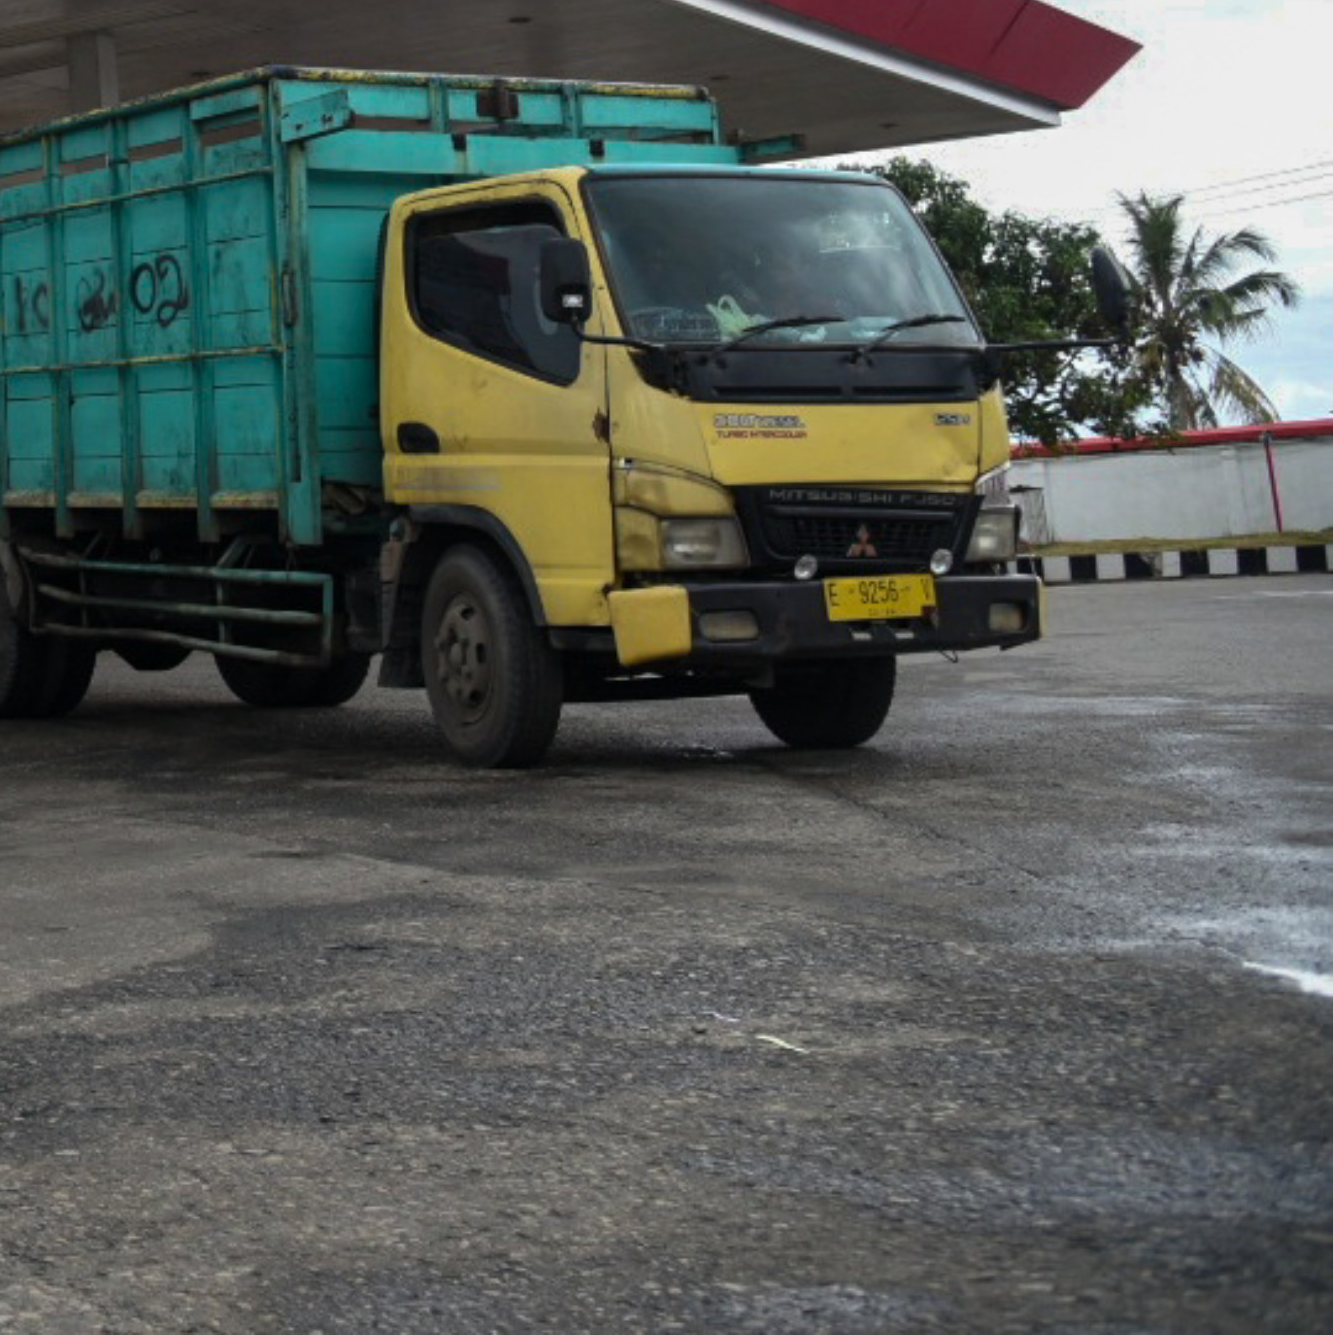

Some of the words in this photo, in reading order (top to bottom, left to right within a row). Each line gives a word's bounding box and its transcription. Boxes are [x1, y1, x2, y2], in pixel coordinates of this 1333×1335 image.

[769, 488, 892, 504] MITSUBISHI
[900, 492, 957, 506] FUSO
[858, 579, 900, 604] 9256
